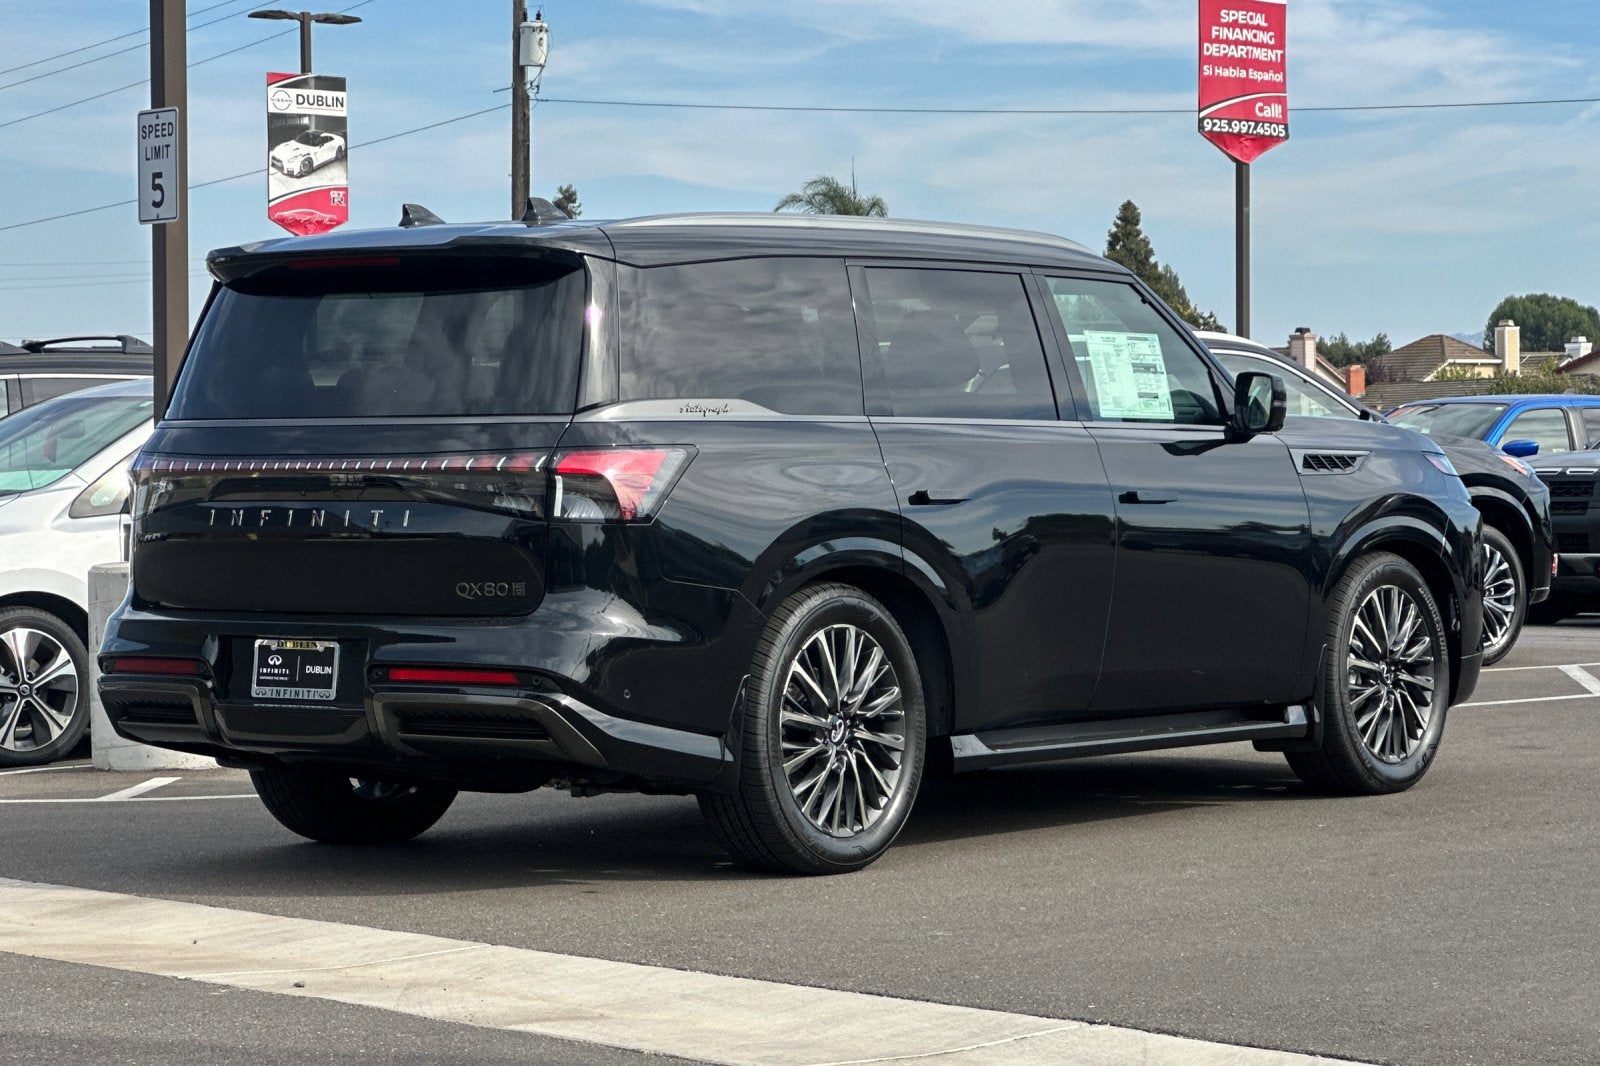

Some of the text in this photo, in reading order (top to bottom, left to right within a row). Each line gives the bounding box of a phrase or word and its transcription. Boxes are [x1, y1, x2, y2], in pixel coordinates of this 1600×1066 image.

[1220, 9, 1268, 26] SPECIAL
[1211, 26, 1275, 45] FINANCING
[1203, 43, 1283, 63] DEPARTMENT
[1203, 65, 1283, 83] Si Habla Español
[296, 94, 344, 108] DUBLIN
[1255, 102, 1282, 119] Call!
[141, 121, 174, 140] SPEED
[1203, 119, 1286, 137] 925.997.4505
[145, 144, 171, 161] LIMIT
[151, 171, 165, 209] 5
[209, 509, 411, 528] INFINITI
[456, 582, 509, 599] QX80
[259, 667, 289, 675] INFINITI
[305, 665, 332, 675] DUBLIN
